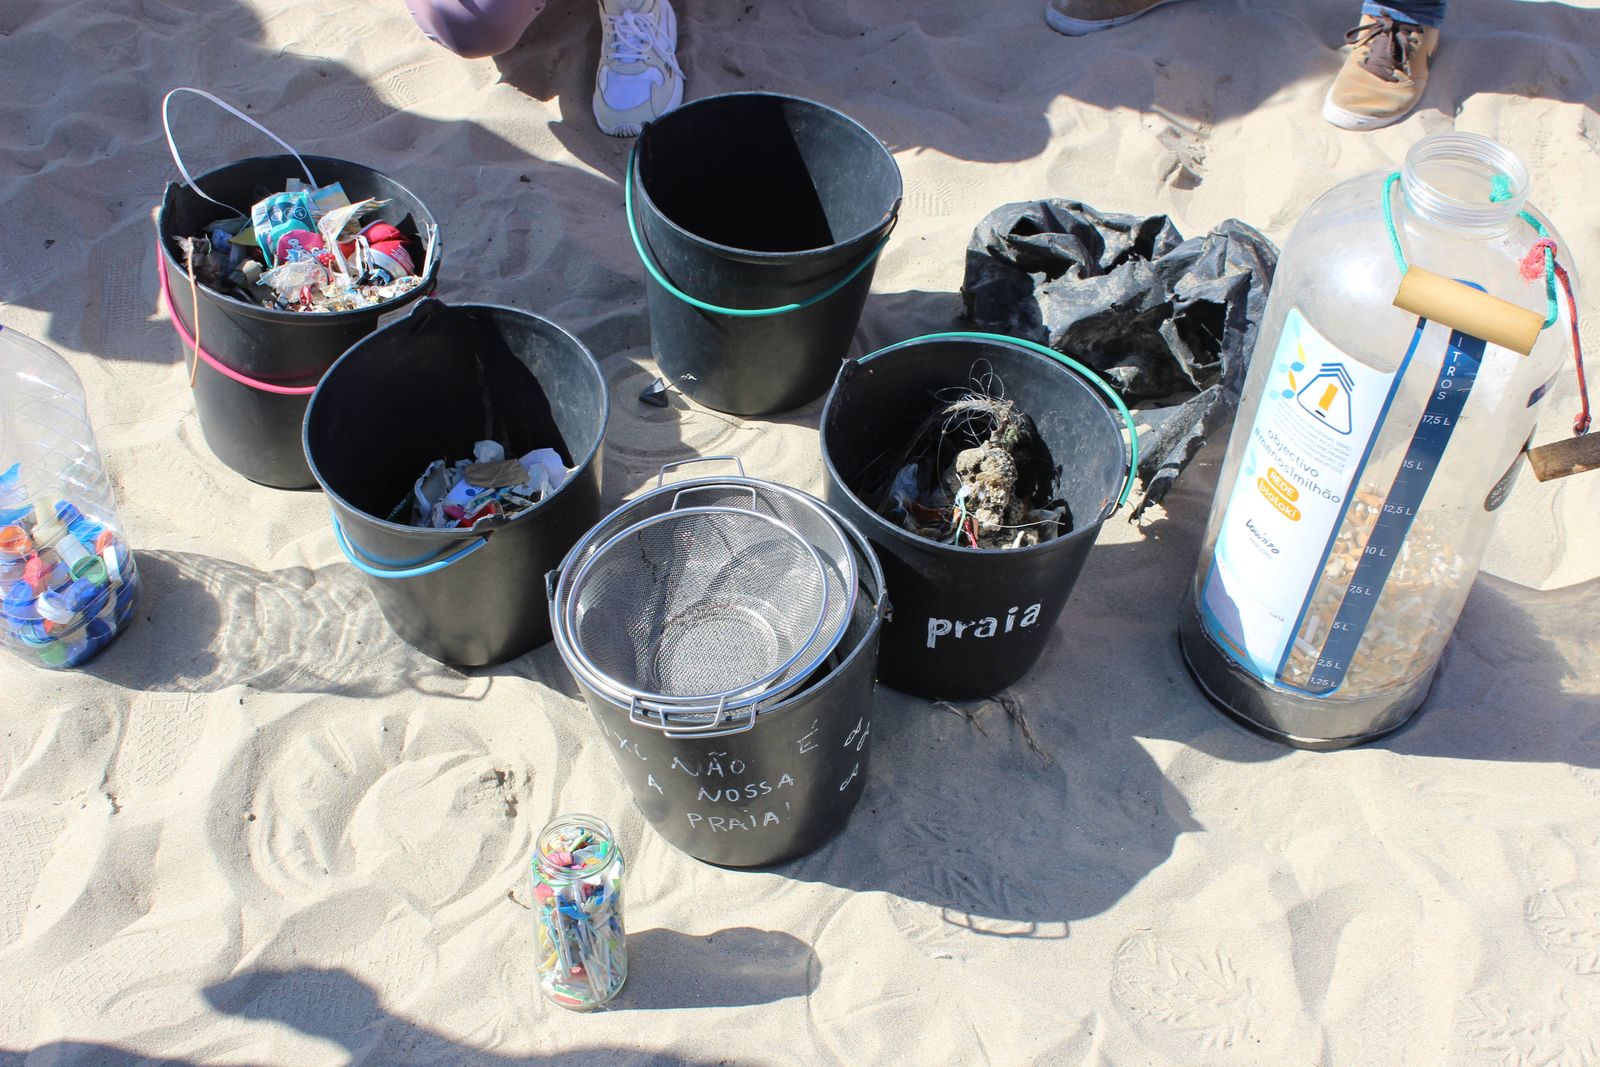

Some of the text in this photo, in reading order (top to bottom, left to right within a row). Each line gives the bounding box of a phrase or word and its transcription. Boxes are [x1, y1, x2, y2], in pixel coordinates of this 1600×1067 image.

[1437, 337, 1462, 400] ITROS
[1422, 414, 1450, 426] 17,5 L
[1267, 429, 1319, 478] objectivo
[1402, 460, 1423, 470] 15 L
[1270, 471, 1294, 499] REDE
[1383, 504, 1413, 516] 12,5 L
[1365, 545, 1387, 557] 10 L
[1349, 585, 1372, 596] 7,5 L
[926, 602, 1042, 649] praia
[1342, 623, 1349, 631] L
[1317, 659, 1341, 670] 2,5 L
[1310, 677, 1337, 688] 1,25 L
[671, 750, 746, 778] NÃO
[647, 772, 795, 803] A NOSSA
